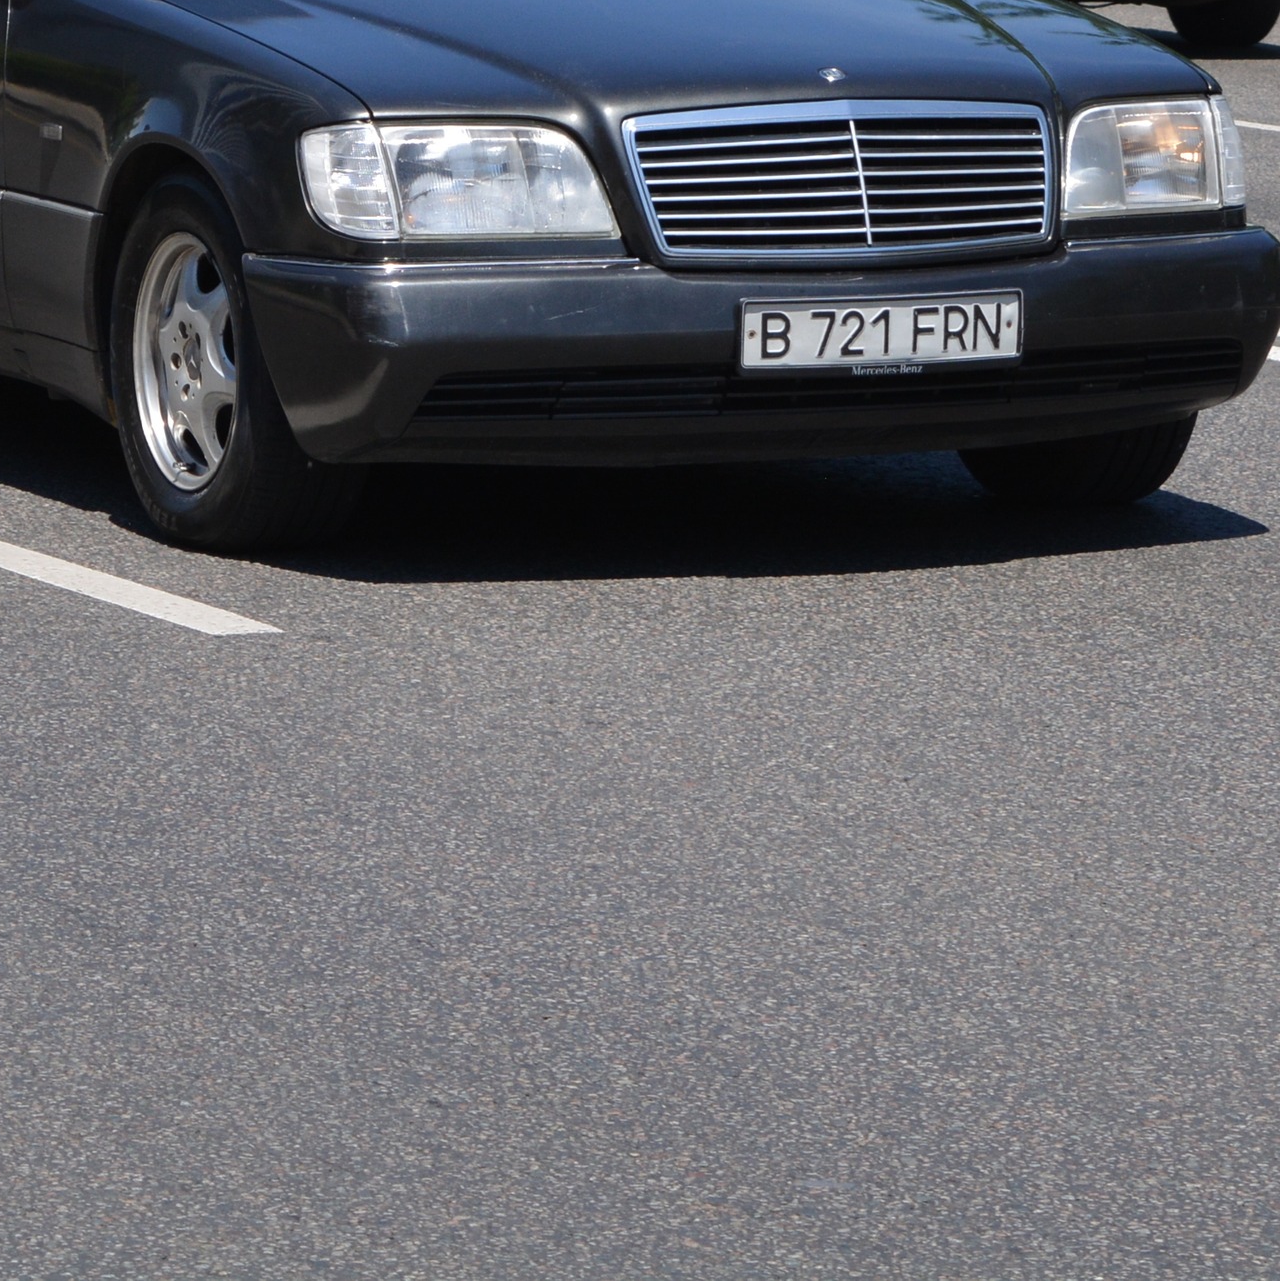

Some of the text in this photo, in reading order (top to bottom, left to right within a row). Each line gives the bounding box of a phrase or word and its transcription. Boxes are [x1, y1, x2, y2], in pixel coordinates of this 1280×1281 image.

[761, 302, 1002, 359] B 721 FRN
[851, 365, 923, 377] Mercedes-Benz
